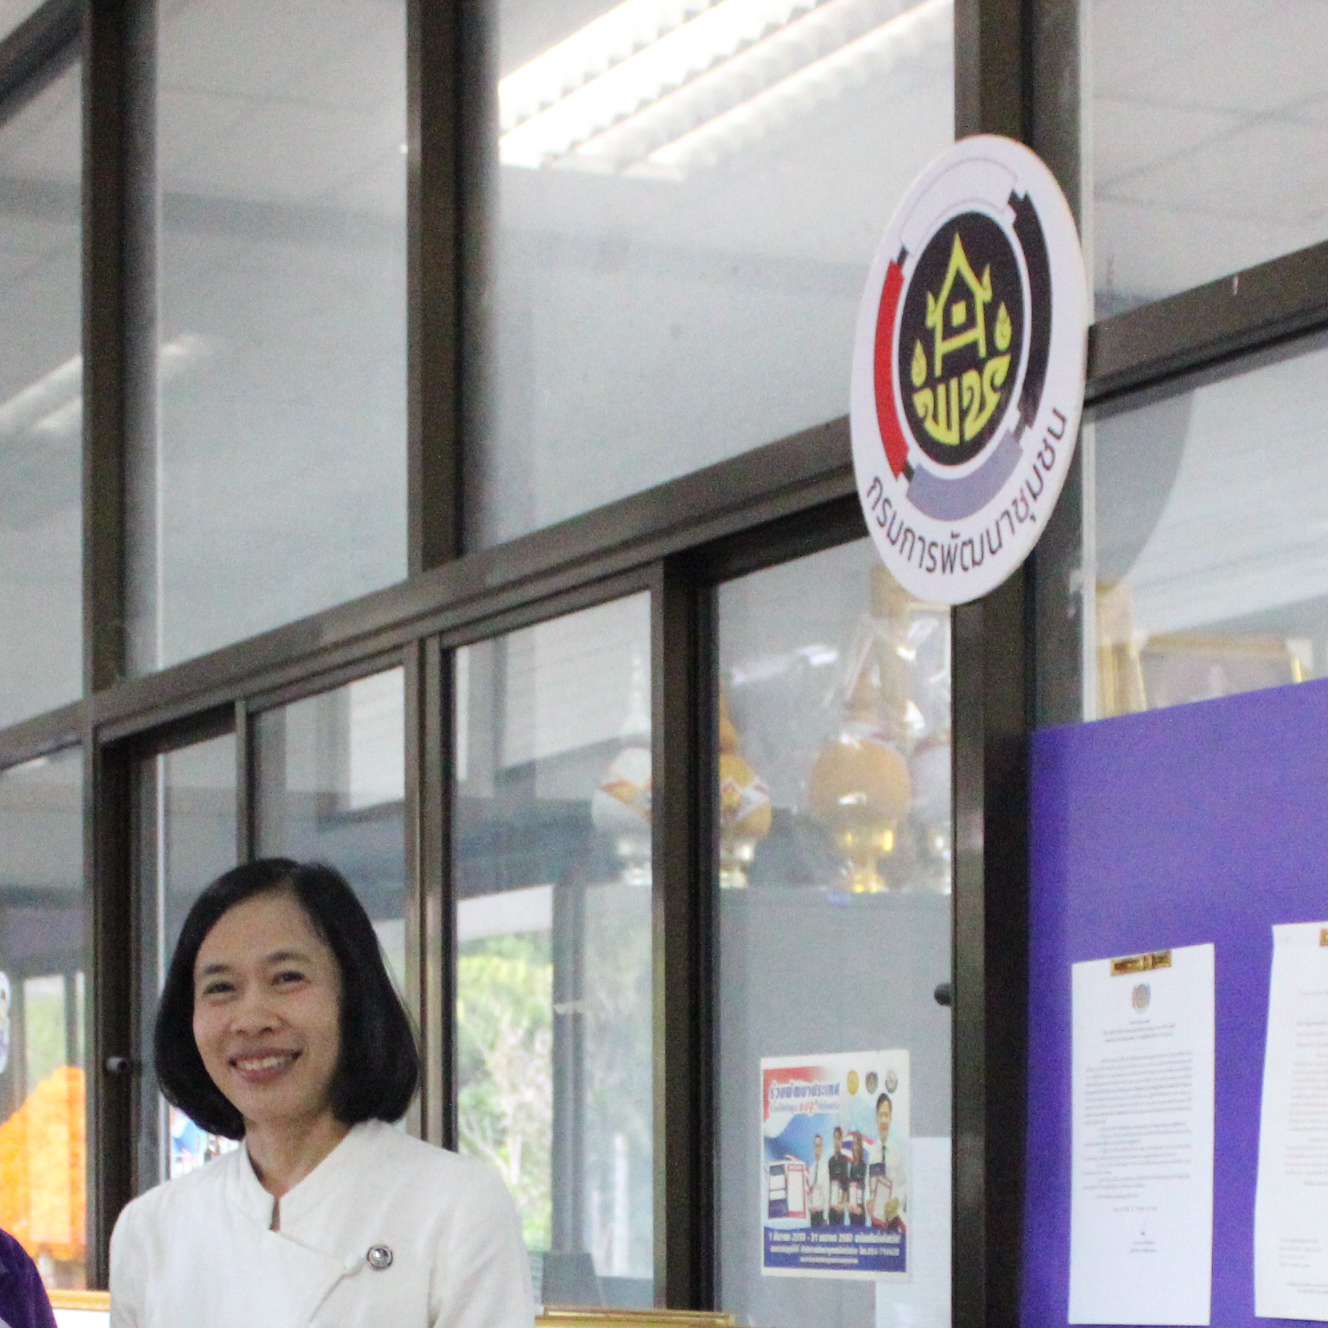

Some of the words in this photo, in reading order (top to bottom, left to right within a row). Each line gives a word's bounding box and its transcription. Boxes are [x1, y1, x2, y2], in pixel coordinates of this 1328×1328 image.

[866, 408, 1068, 576] กรมการพัฒนาชุมชน
